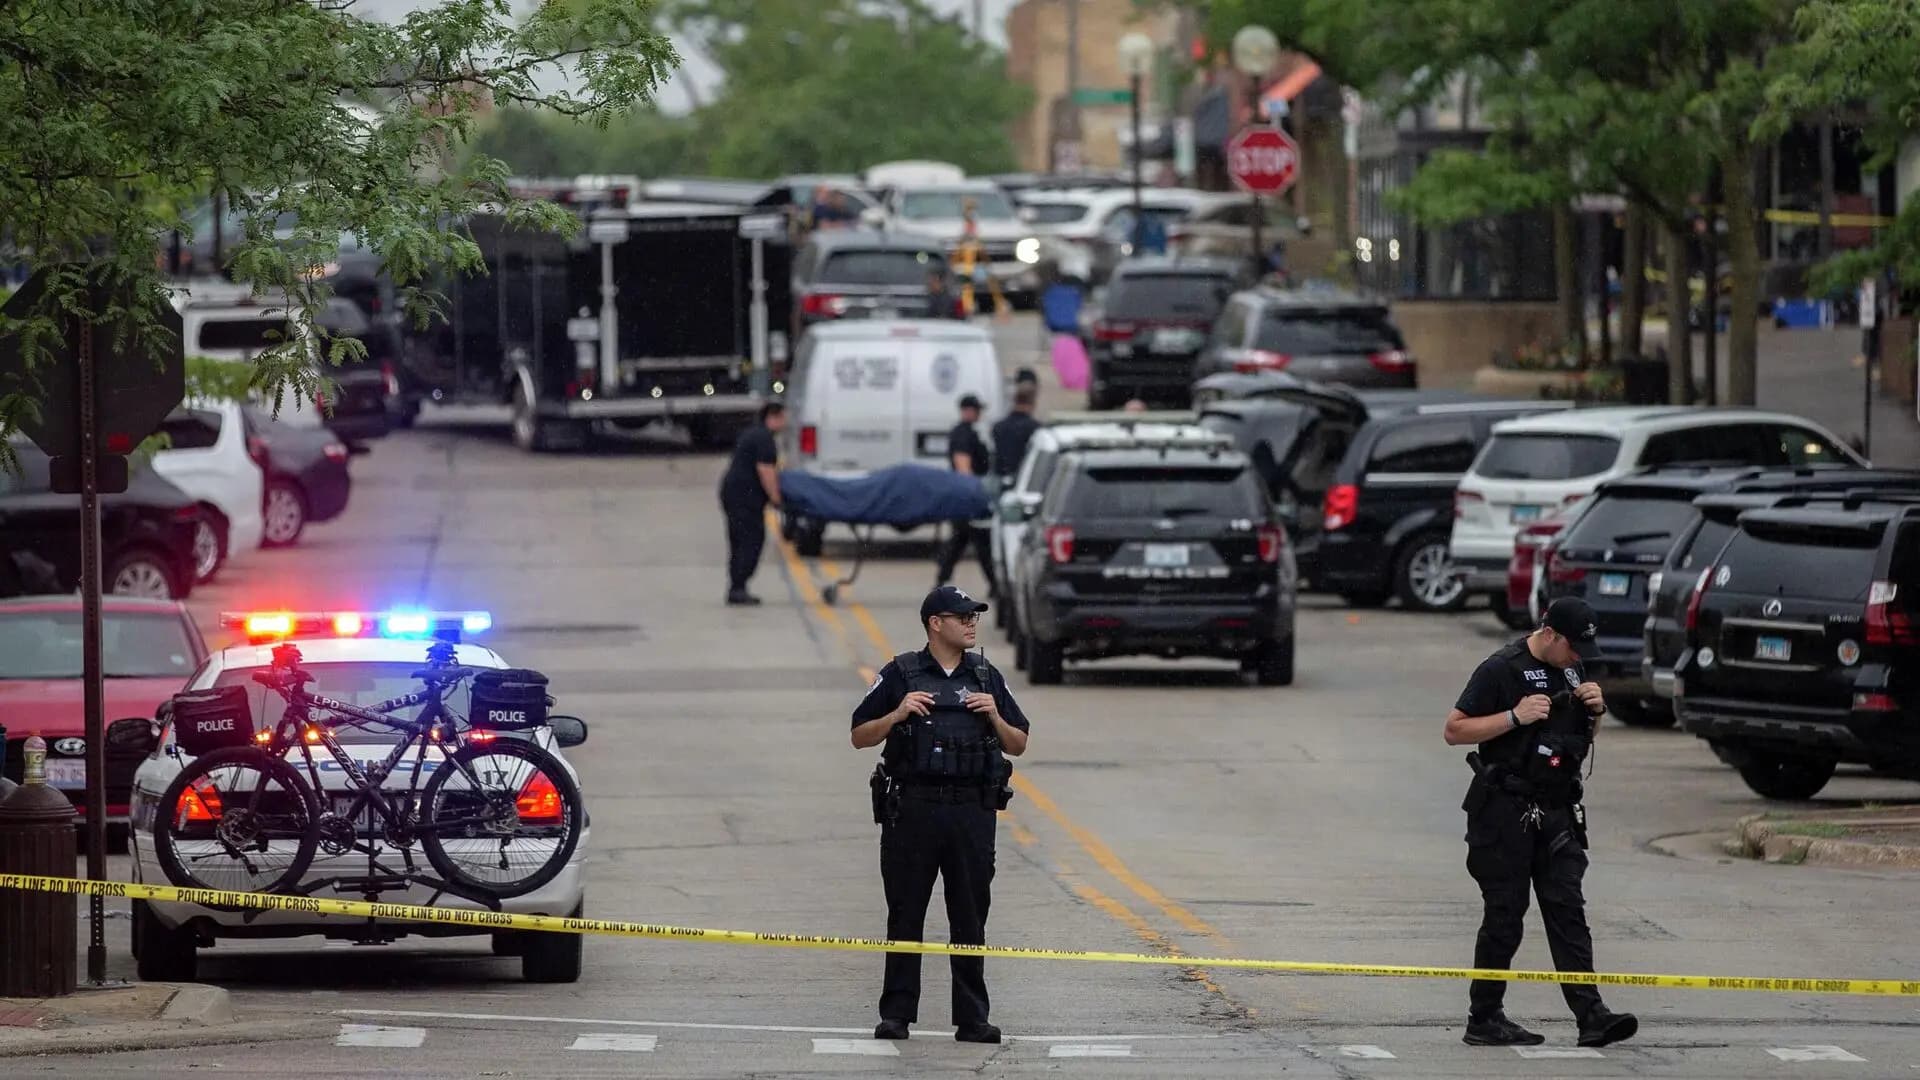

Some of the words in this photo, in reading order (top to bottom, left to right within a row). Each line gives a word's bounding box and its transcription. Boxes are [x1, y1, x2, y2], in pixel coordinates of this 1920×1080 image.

[1232, 147, 1295, 175] STOP
[1523, 669, 1548, 681] POLICE
[313, 695, 340, 709] LPD
[489, 710, 526, 722] POLICE
[197, 718, 235, 733] POLICE
[483, 770, 508, 785] 17
[23, 877, 46, 891] LINE
[49, 879, 63, 892] DO
[67, 880, 88, 894] NOT
[91, 882, 126, 897] CROSS
[176, 889, 214, 905] POLICE
[217, 892, 240, 906] LINE
[243, 894, 258, 908] DO
[261, 895, 282, 909] NOT
[285, 897, 320, 912] CROSS
[371, 904, 408, 918] POLICE
[411, 907, 433, 920] LINE
[437, 909, 451, 921] DO
[454, 910, 475, 923] NOT
[478, 912, 513, 925] CROSS
[563, 919, 600, 931] POLICE
[603, 922, 626, 932] LINE
[629, 923, 644, 933] DO
[647, 925, 667, 935] NOT
